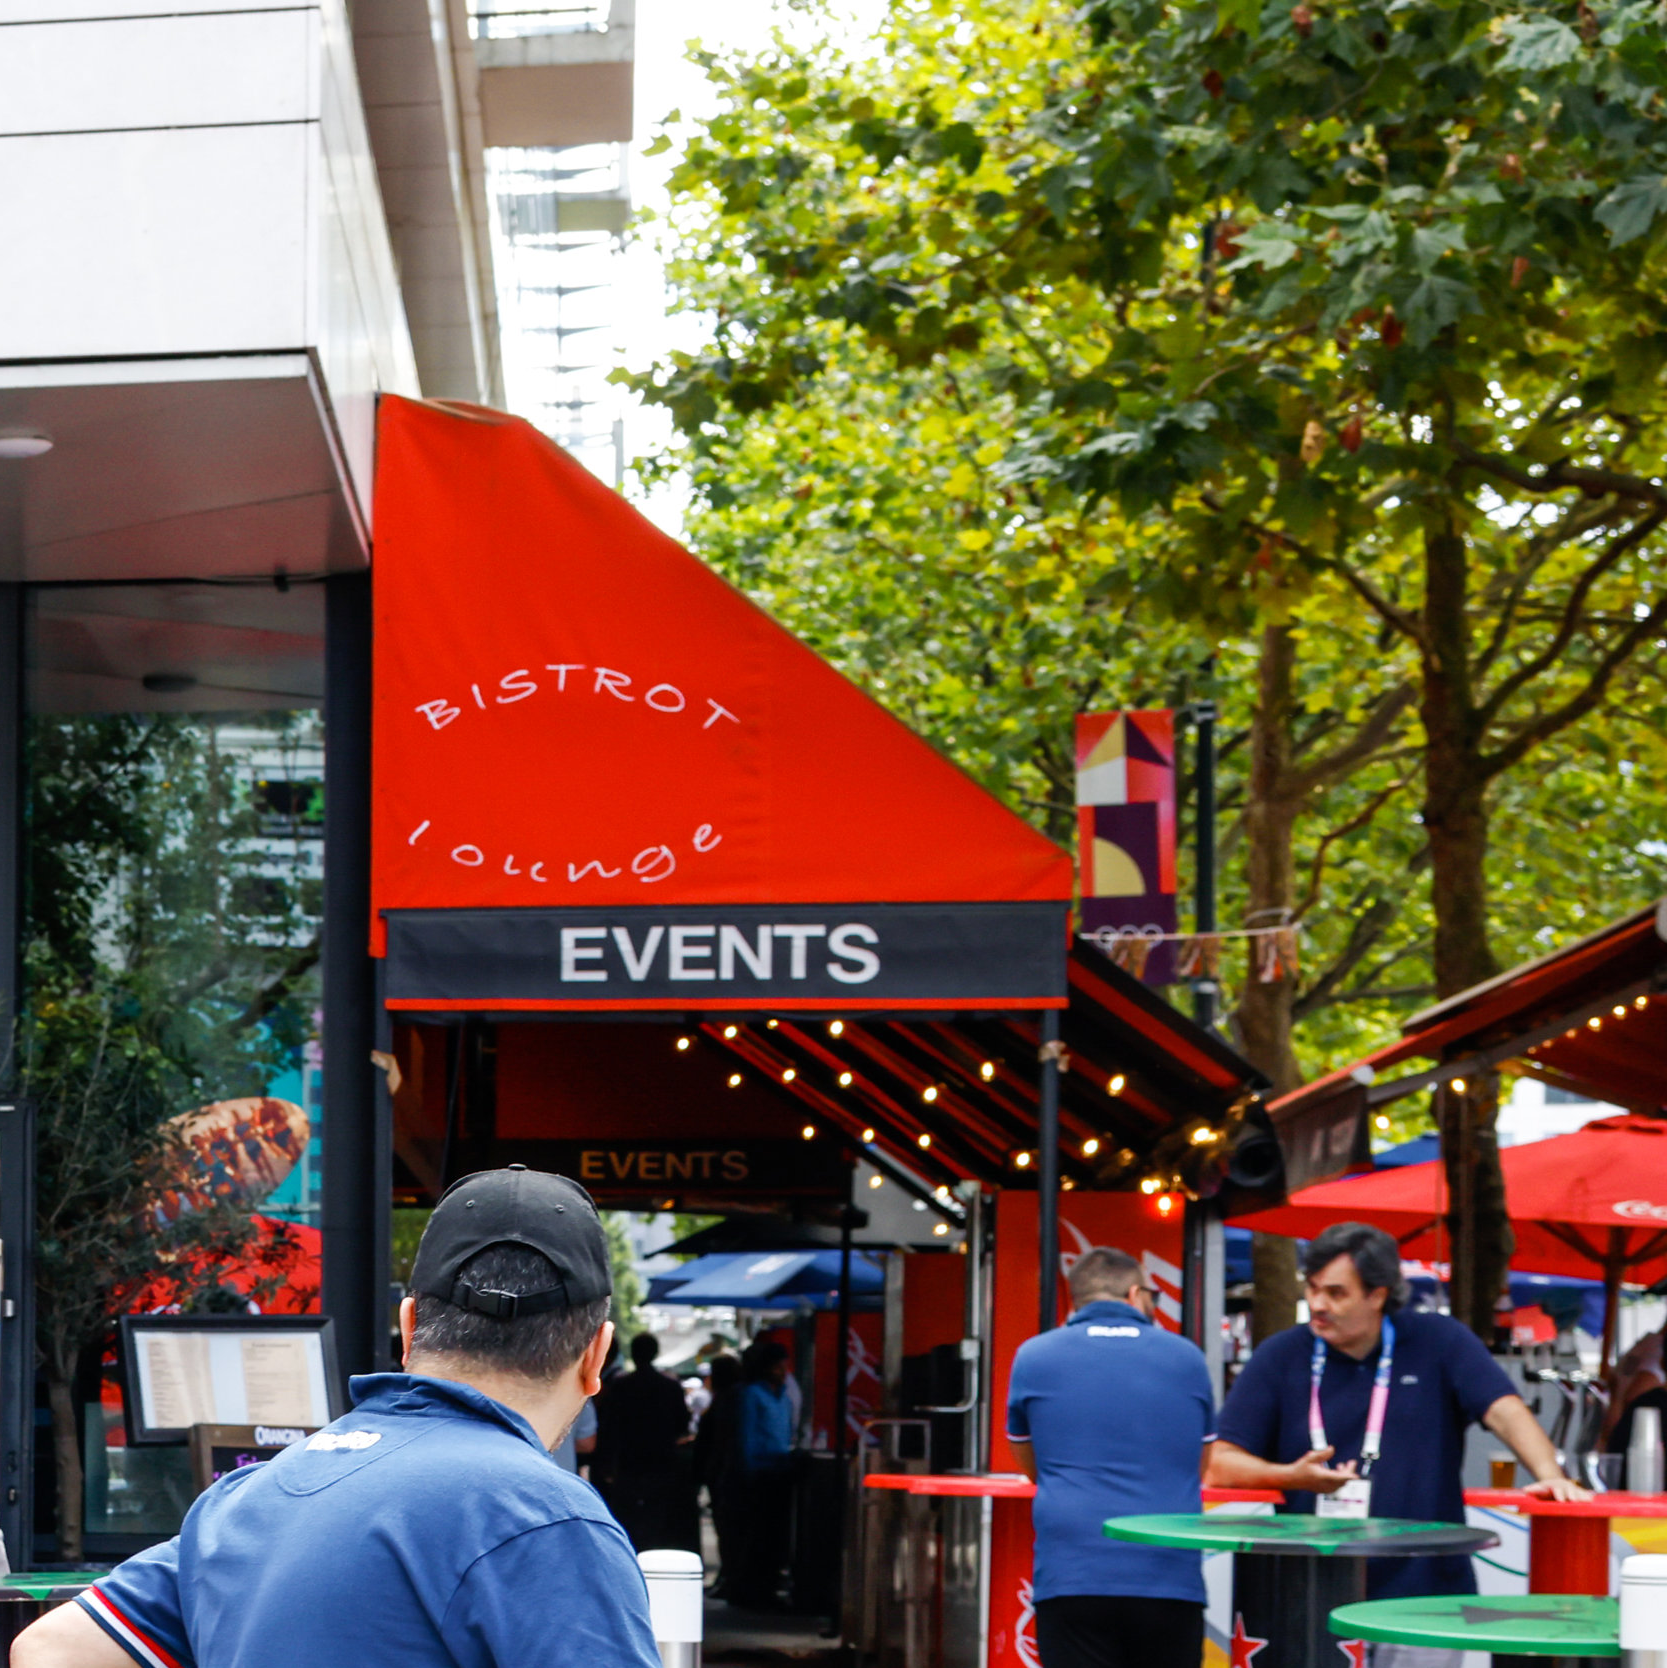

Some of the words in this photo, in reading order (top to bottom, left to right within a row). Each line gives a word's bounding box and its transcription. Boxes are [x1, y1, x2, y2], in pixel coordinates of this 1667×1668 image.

[413, 663, 742, 731] BISTROT
[559, 922, 881, 985] EVENTS
[580, 1150, 749, 1181] EVENTS
